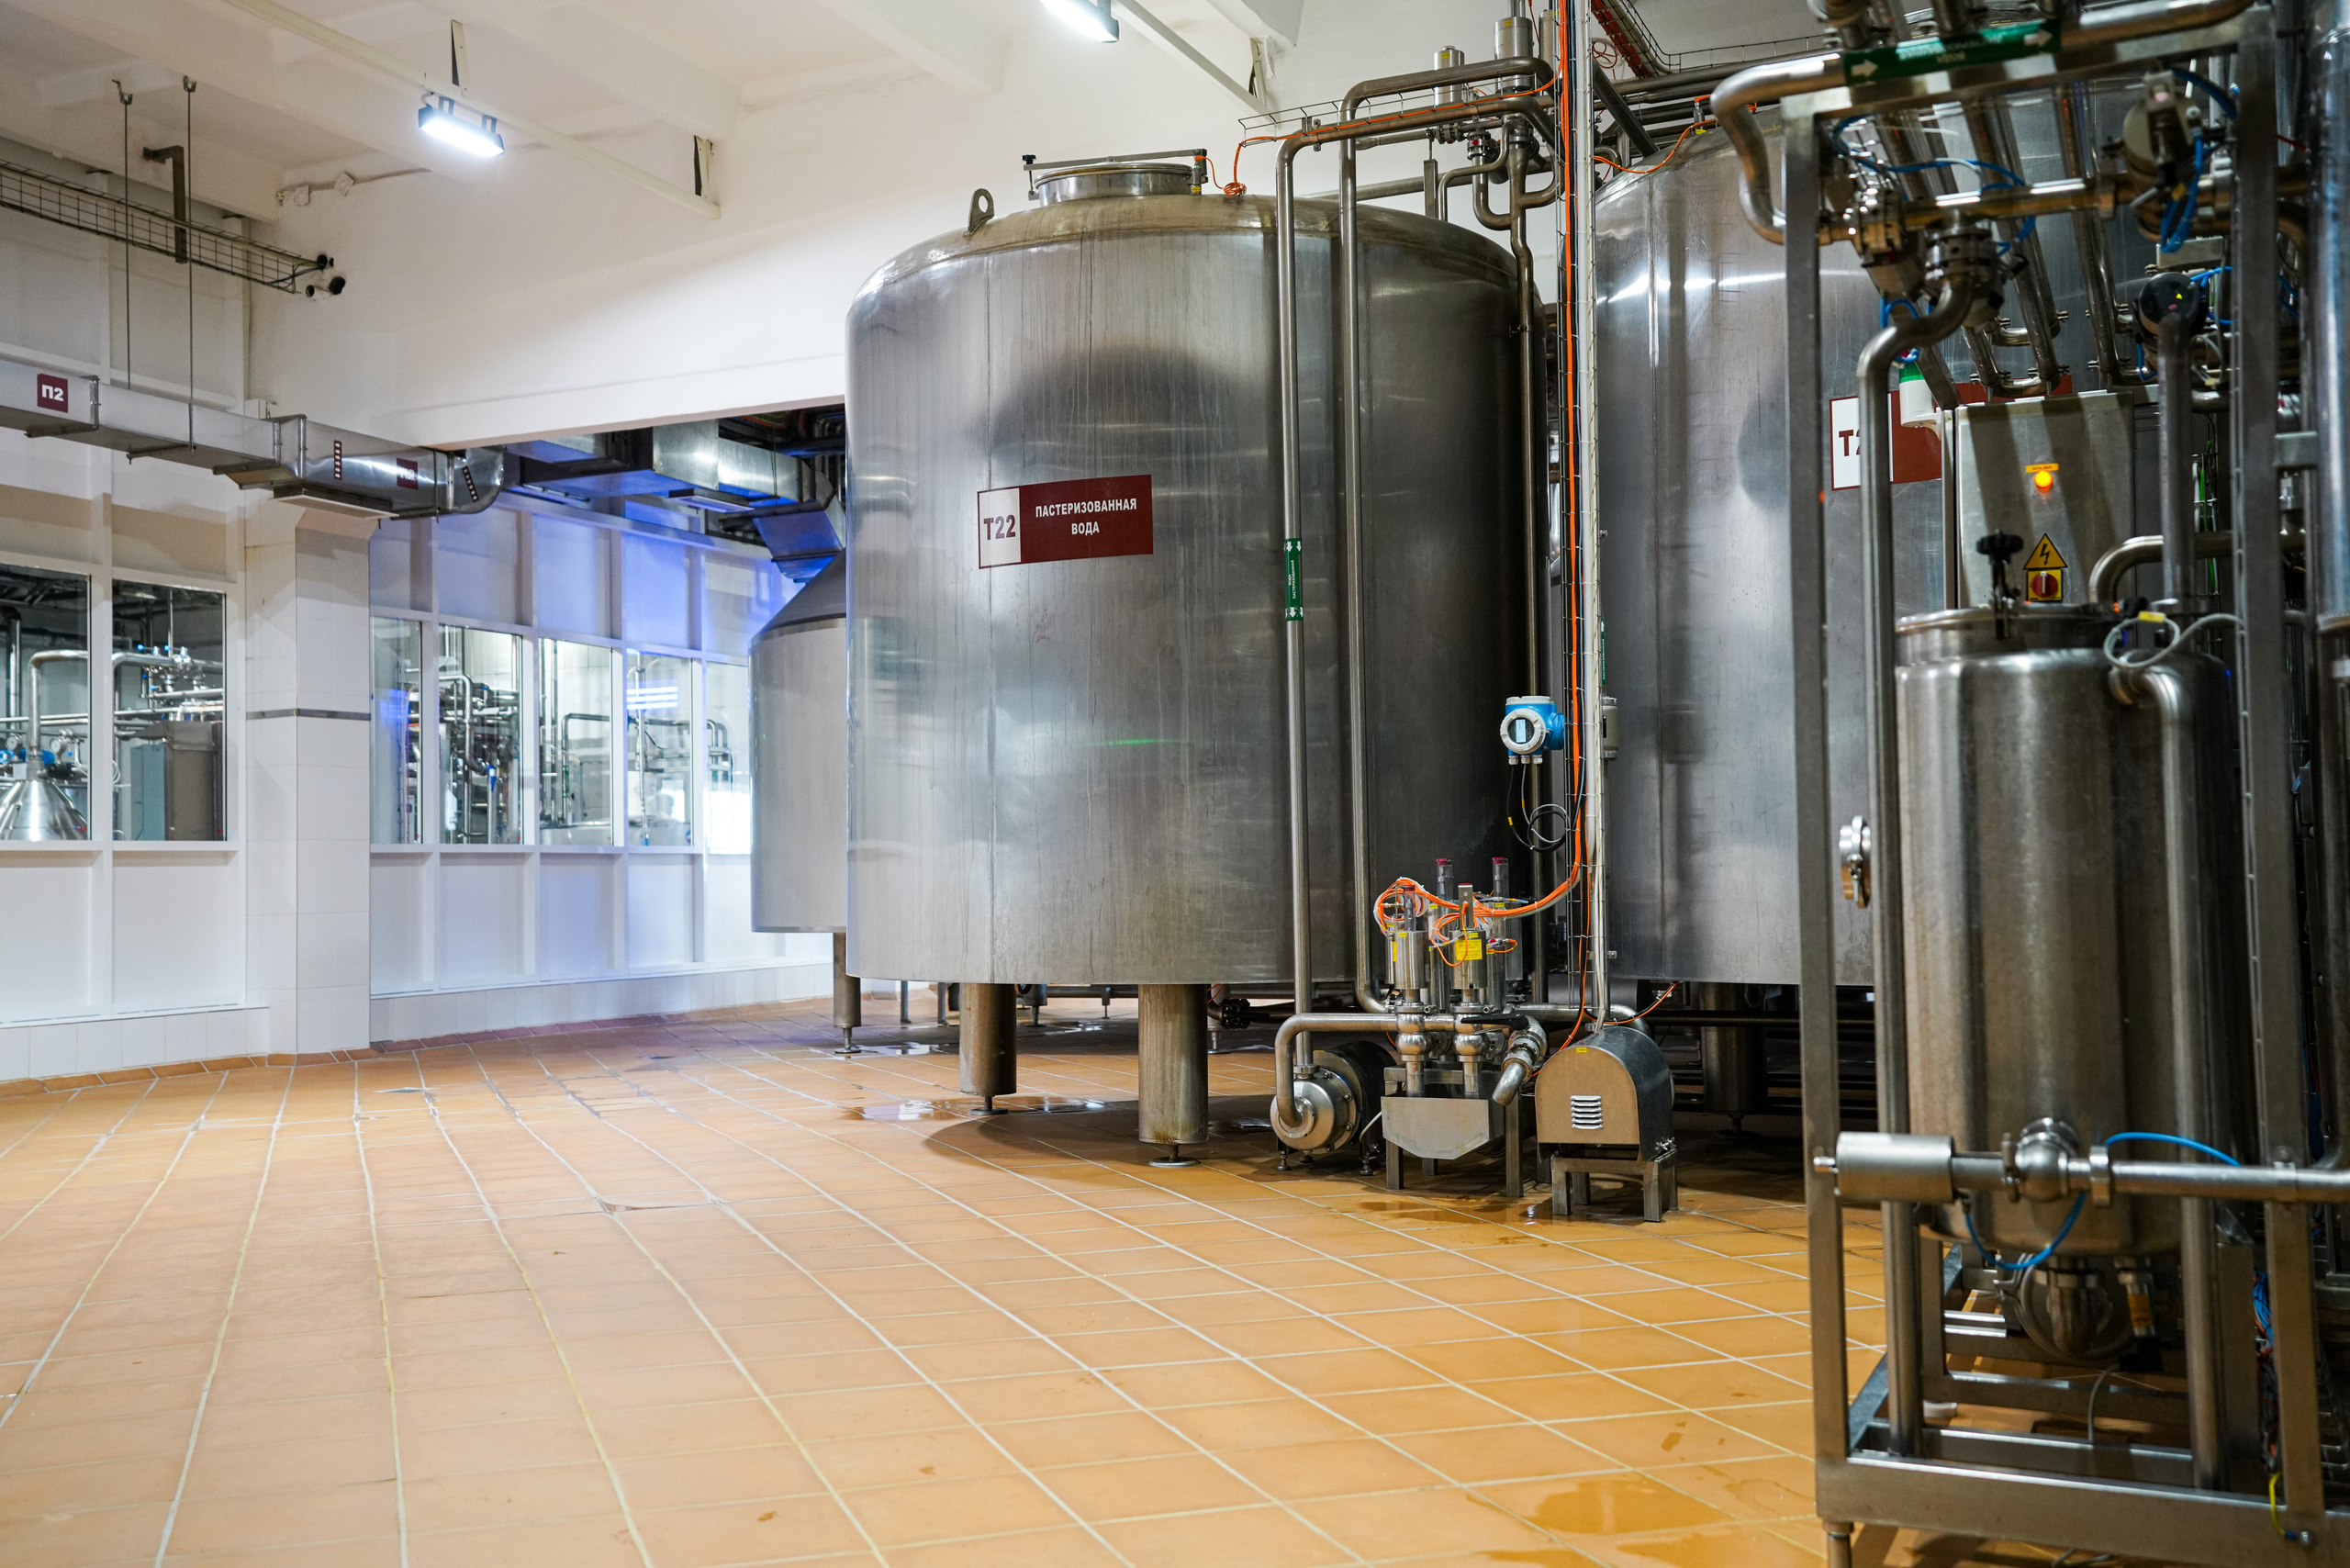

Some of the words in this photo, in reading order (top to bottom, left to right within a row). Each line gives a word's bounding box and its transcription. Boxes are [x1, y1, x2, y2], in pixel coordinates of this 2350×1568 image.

[42, 384, 64, 402] П2
[1035, 498, 1137, 518] ПАСТЕРИЗОВАННАЯ
[983, 514, 1016, 541] Т22
[1071, 521, 1100, 536] ВОДА
